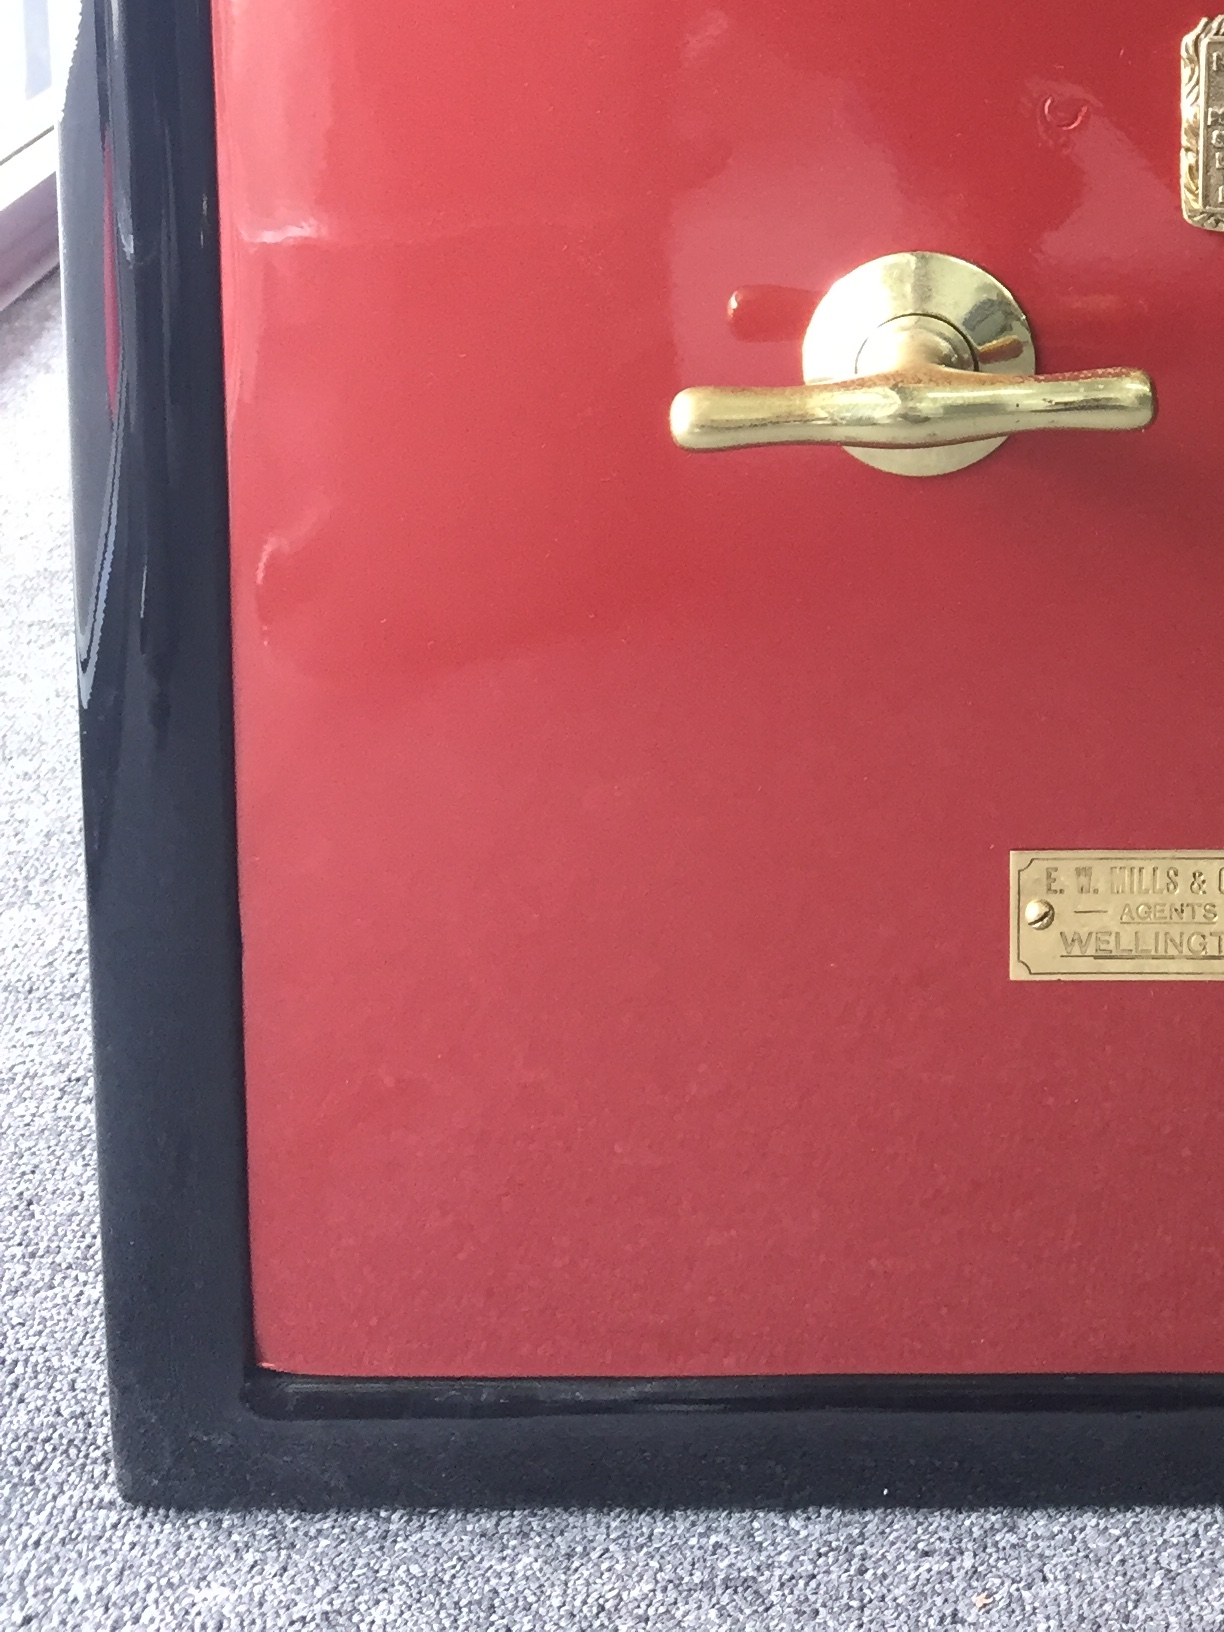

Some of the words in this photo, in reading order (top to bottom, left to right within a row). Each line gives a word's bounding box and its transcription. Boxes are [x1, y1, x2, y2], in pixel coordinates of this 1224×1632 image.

[1045, 866, 1066, 895] E.
[1110, 866, 1179, 895] MILLS
[1190, 870, 1207, 895] &
[1120, 902, 1219, 922] AGENTS
